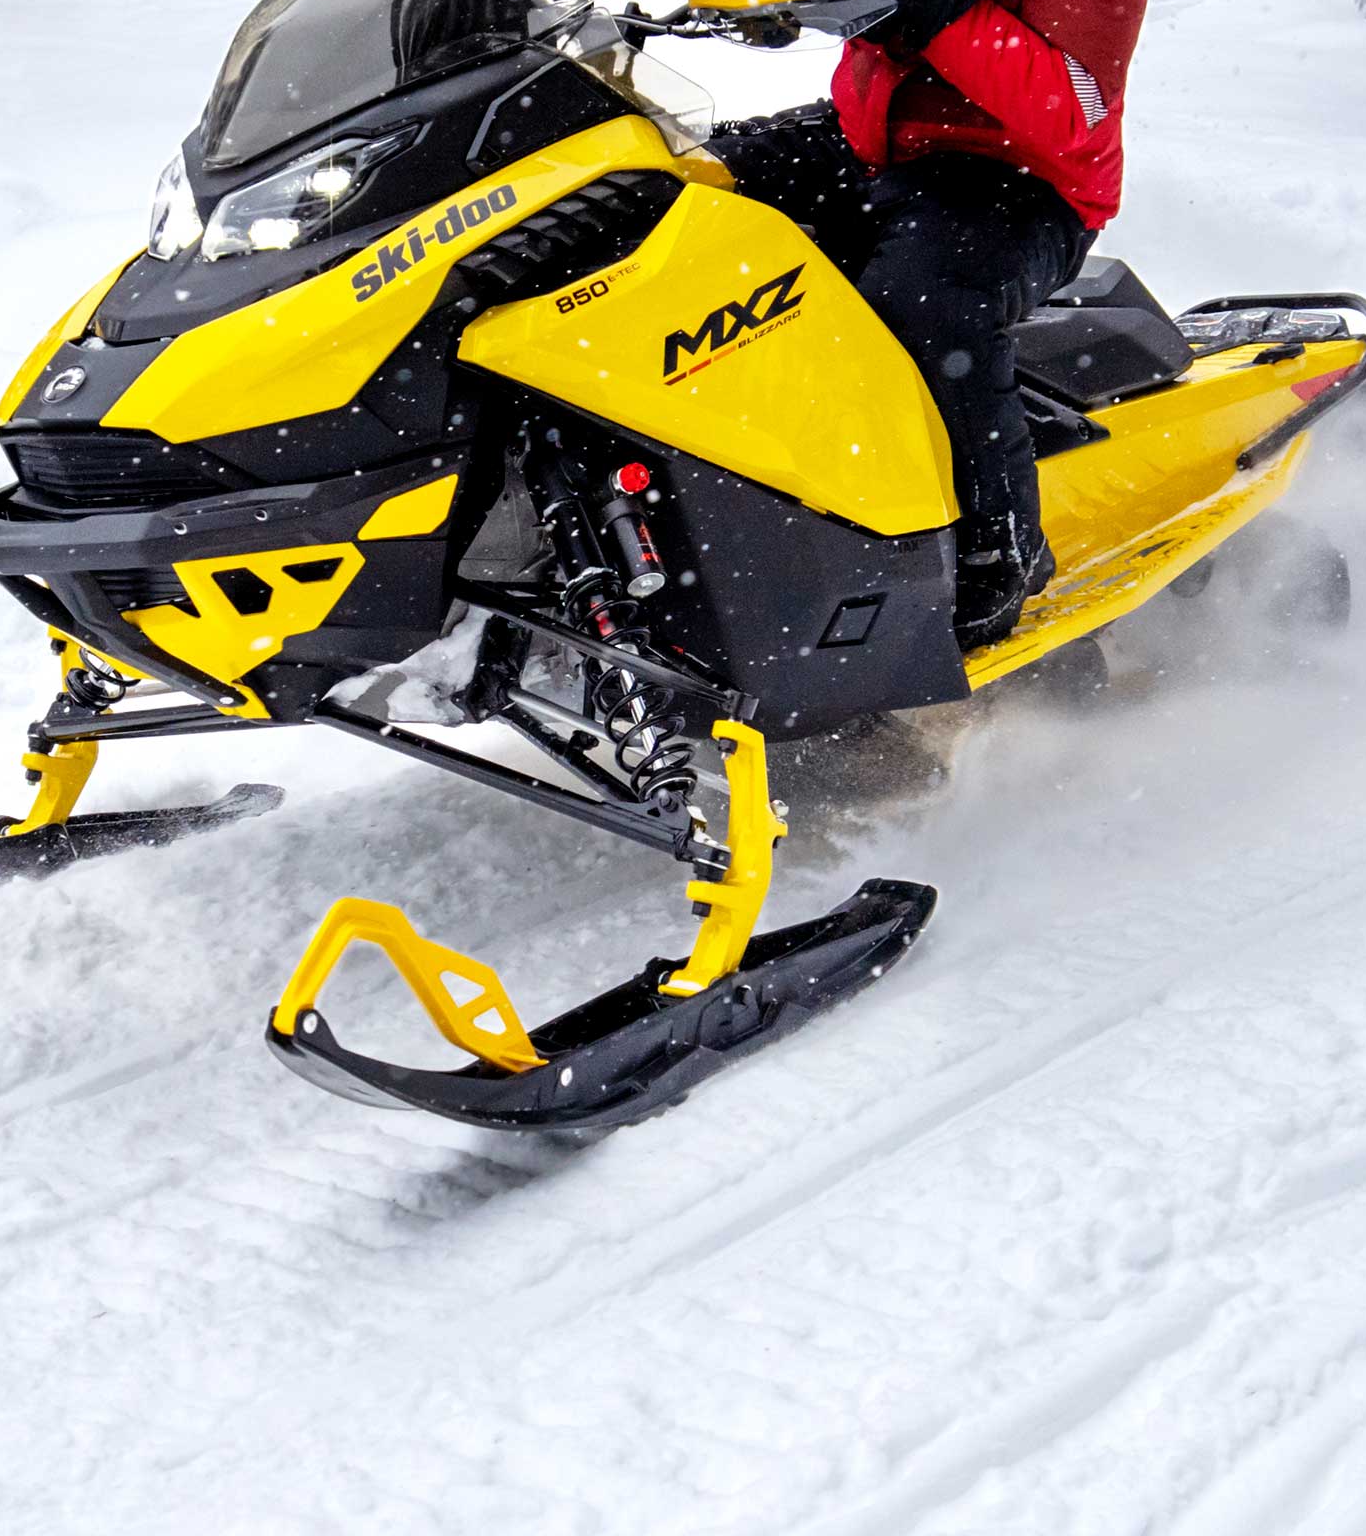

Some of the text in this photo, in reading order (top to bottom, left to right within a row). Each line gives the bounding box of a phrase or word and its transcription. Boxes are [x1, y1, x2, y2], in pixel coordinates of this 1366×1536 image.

[351, 184, 517, 303] ski-doo
[555, 263, 641, 314] 850 E-TEC
[663, 261, 807, 377] MXZ
[738, 309, 801, 349] BLIZZARD
